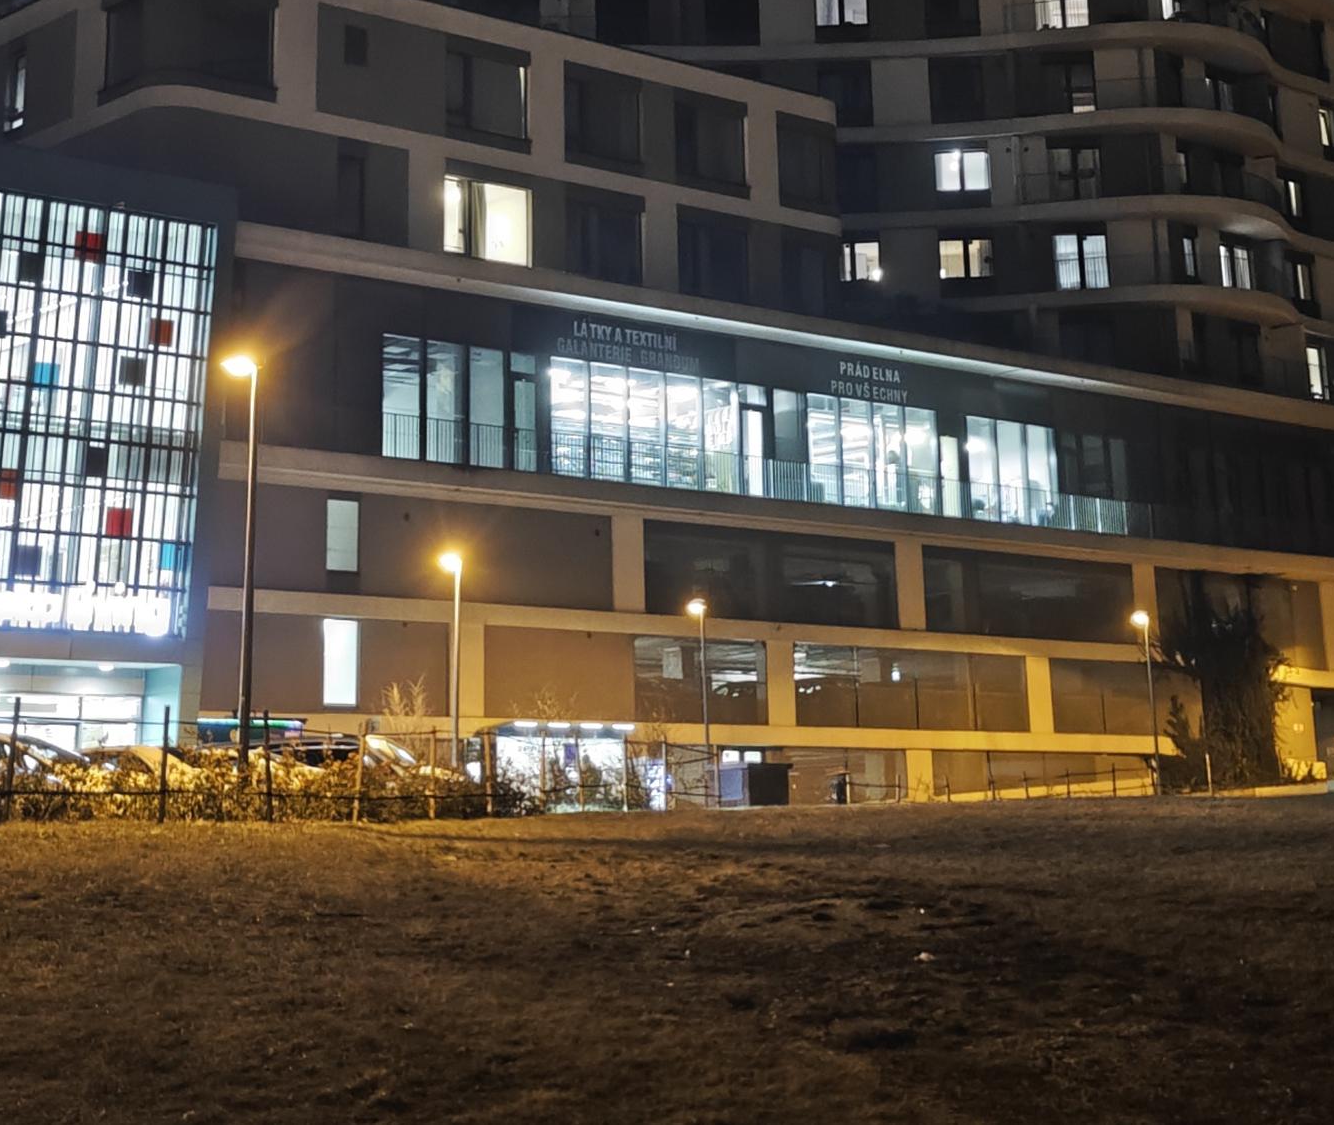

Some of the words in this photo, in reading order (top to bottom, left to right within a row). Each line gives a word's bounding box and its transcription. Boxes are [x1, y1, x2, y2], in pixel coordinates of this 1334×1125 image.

[573, 318, 612, 341] LÁTKY
[614, 328, 623, 343] A
[625, 329, 677, 352] TEXTILNÍ
[557, 337, 632, 363] GALANTERIE
[839, 360, 901, 383] PRÁDELNA
[831, 380, 853, 396] PRO
[855, 382, 908, 403] VŠECHNY
